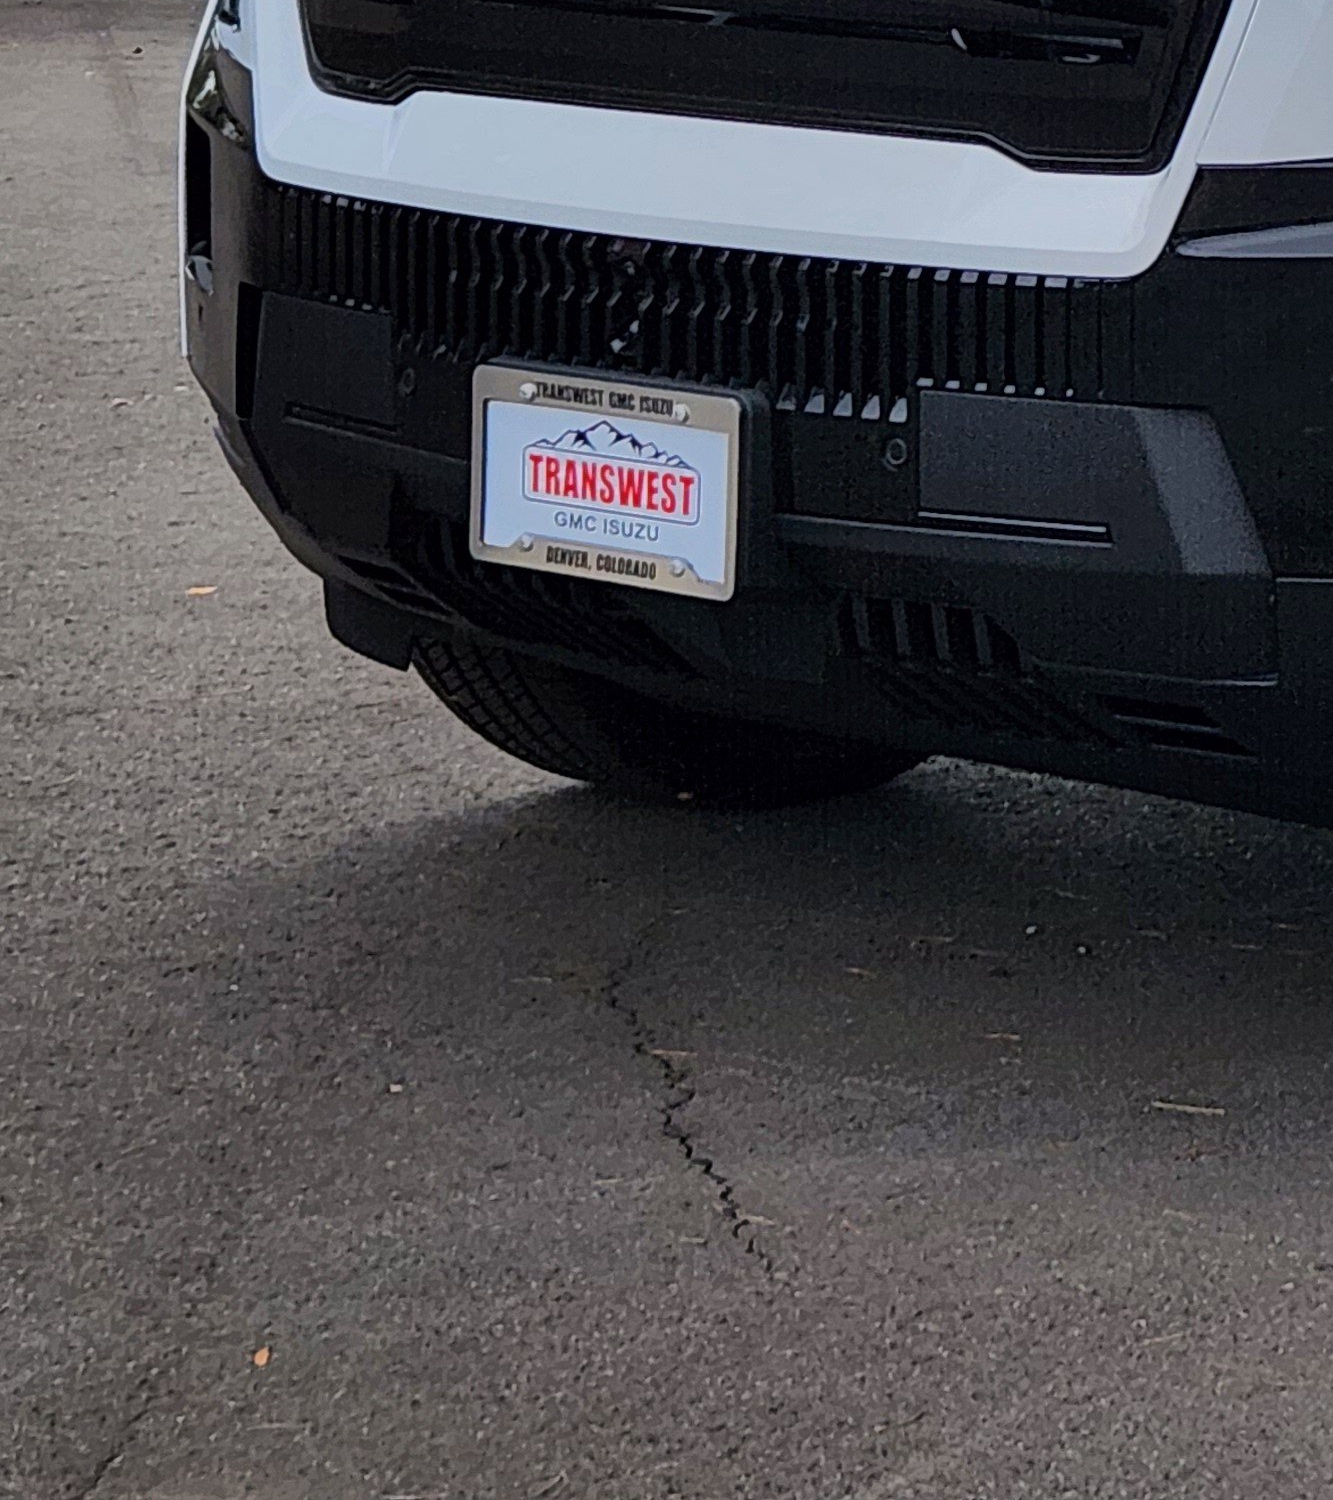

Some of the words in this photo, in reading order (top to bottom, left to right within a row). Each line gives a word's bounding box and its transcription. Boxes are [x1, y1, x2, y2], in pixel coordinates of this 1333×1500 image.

[535, 381, 604, 408] TRANSWEST
[608, 390, 635, 411] GMC
[639, 395, 674, 418] ISUZU
[528, 453, 694, 516] TRANSWEST
[554, 511, 597, 532] GMC
[603, 519, 660, 542] ISUZU
[596, 553, 657, 580] COLORADO
